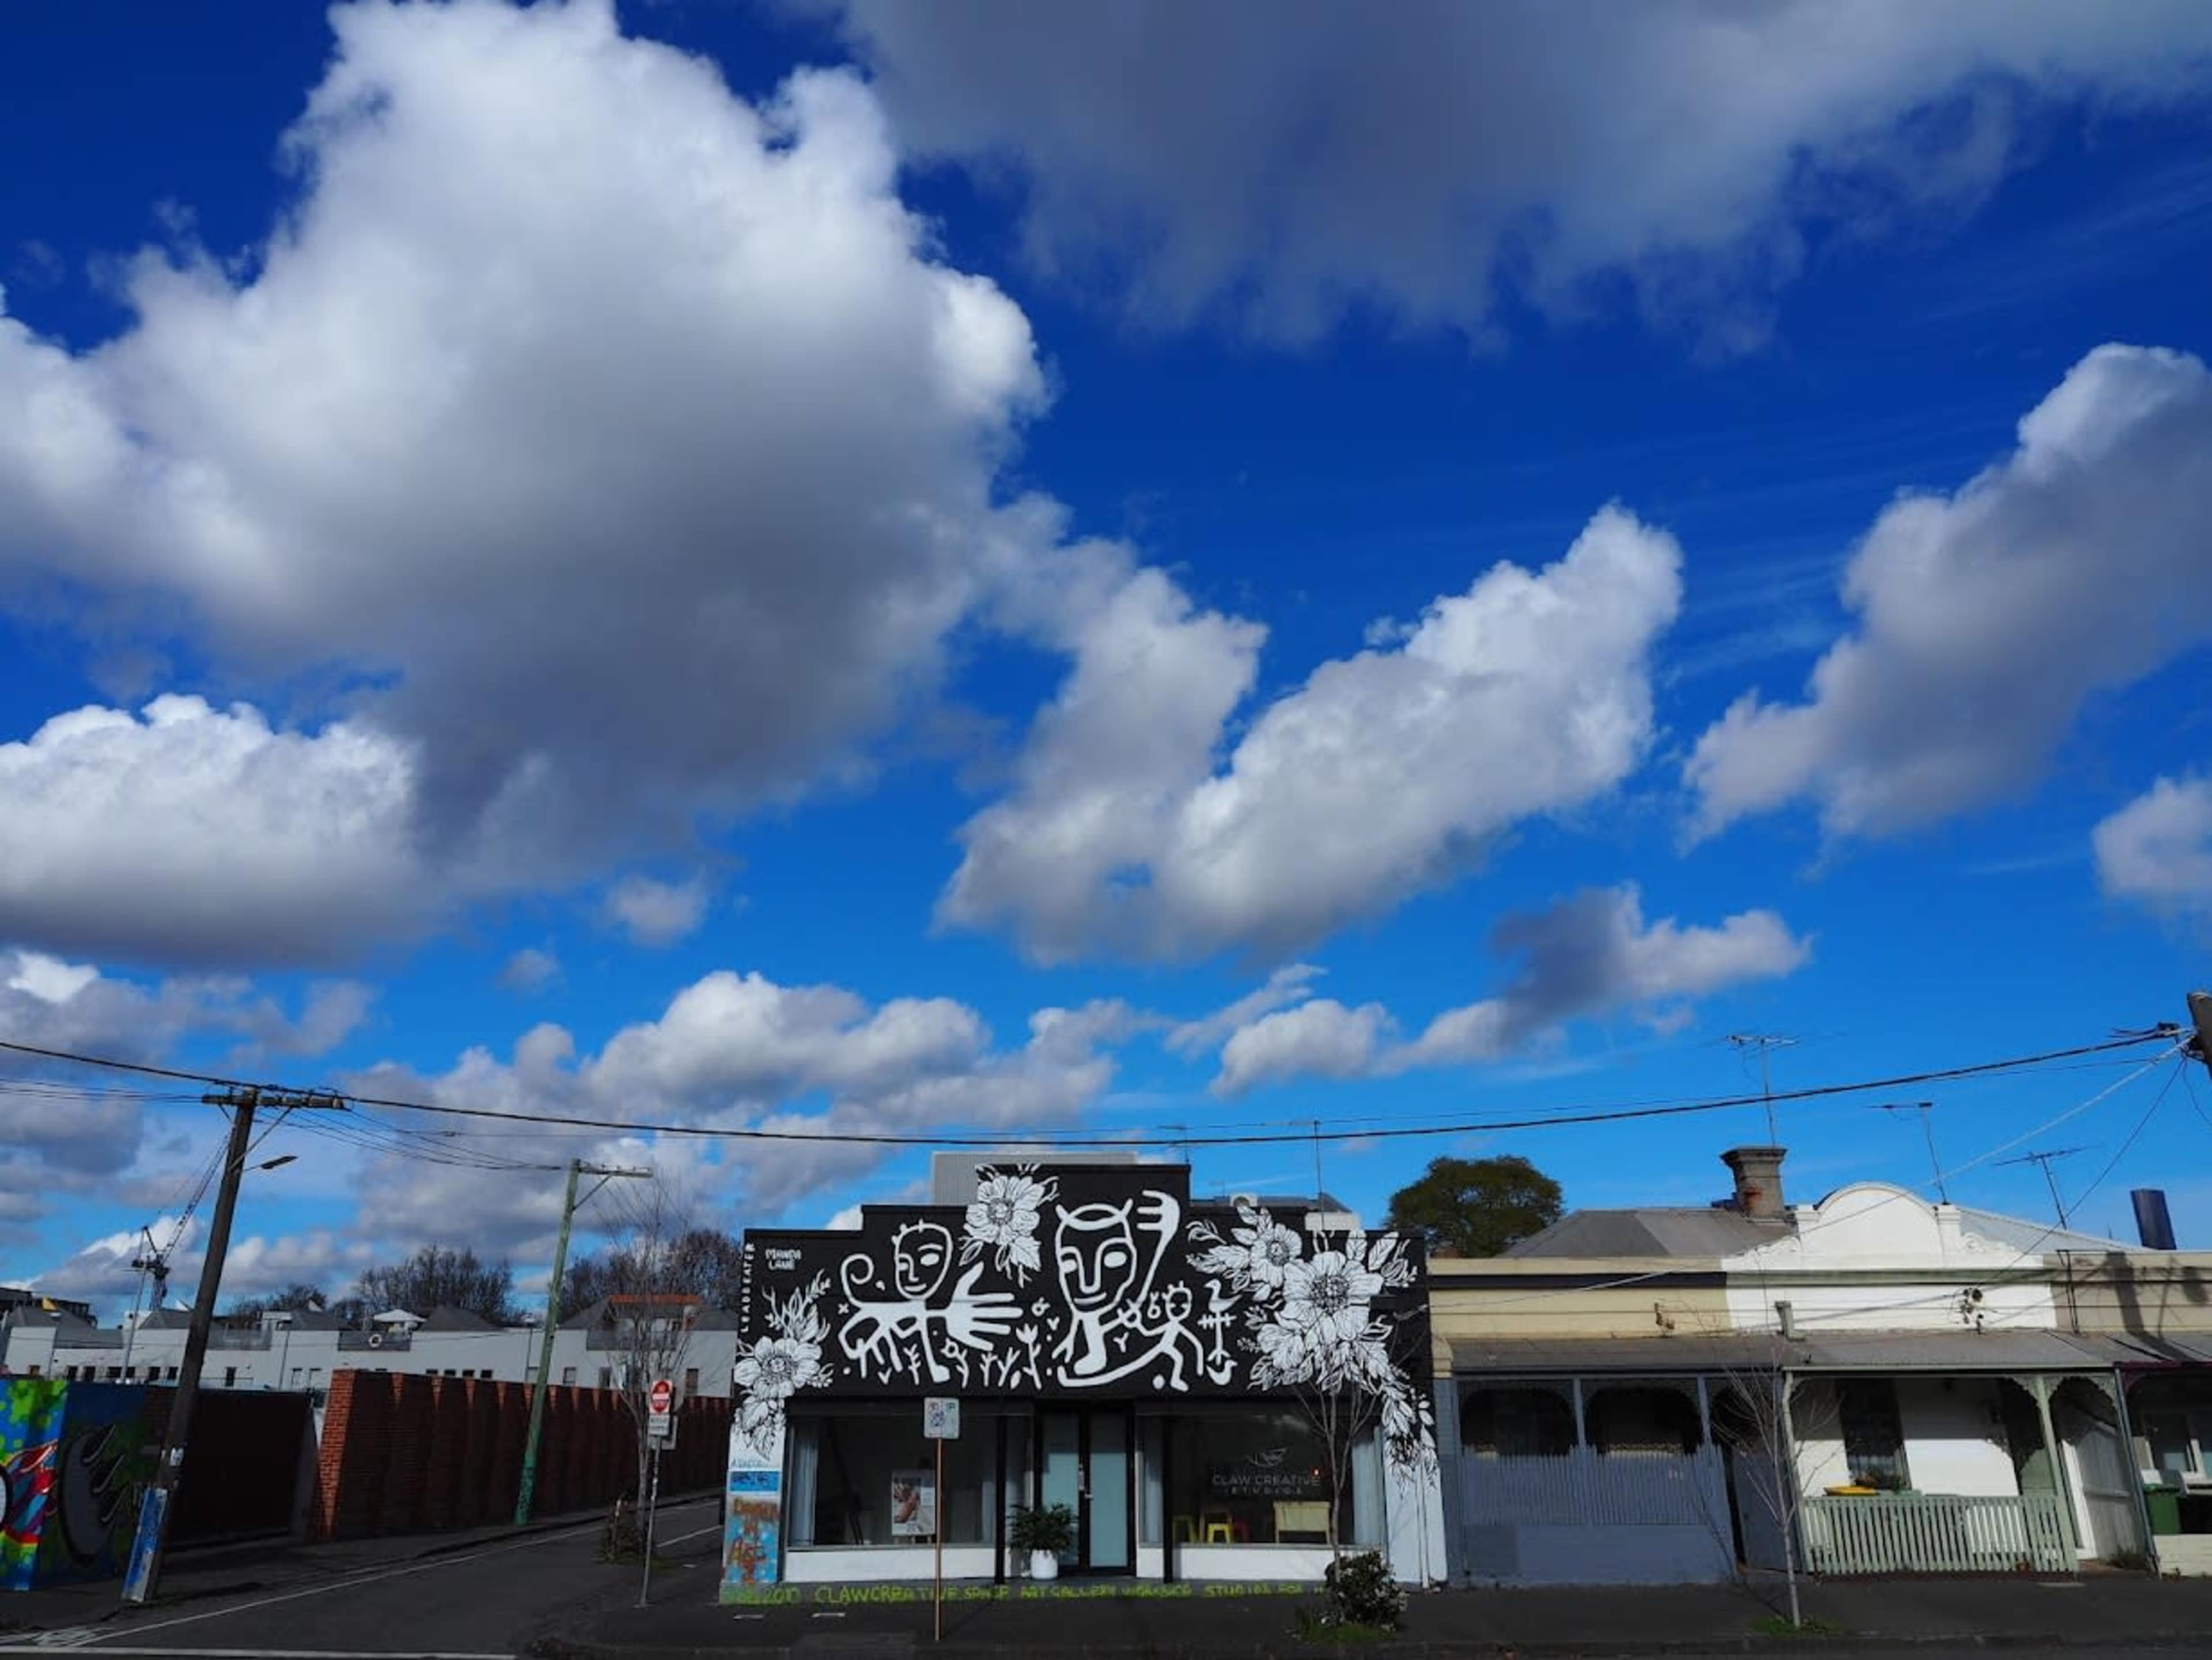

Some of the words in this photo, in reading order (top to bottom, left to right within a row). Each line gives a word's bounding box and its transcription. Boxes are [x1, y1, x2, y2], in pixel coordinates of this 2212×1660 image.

[740, 1242, 756, 1333] LEADBEATER
[1212, 1475, 1250, 1485] CLAW
[1255, 1474, 1321, 1486] CREATIVE
